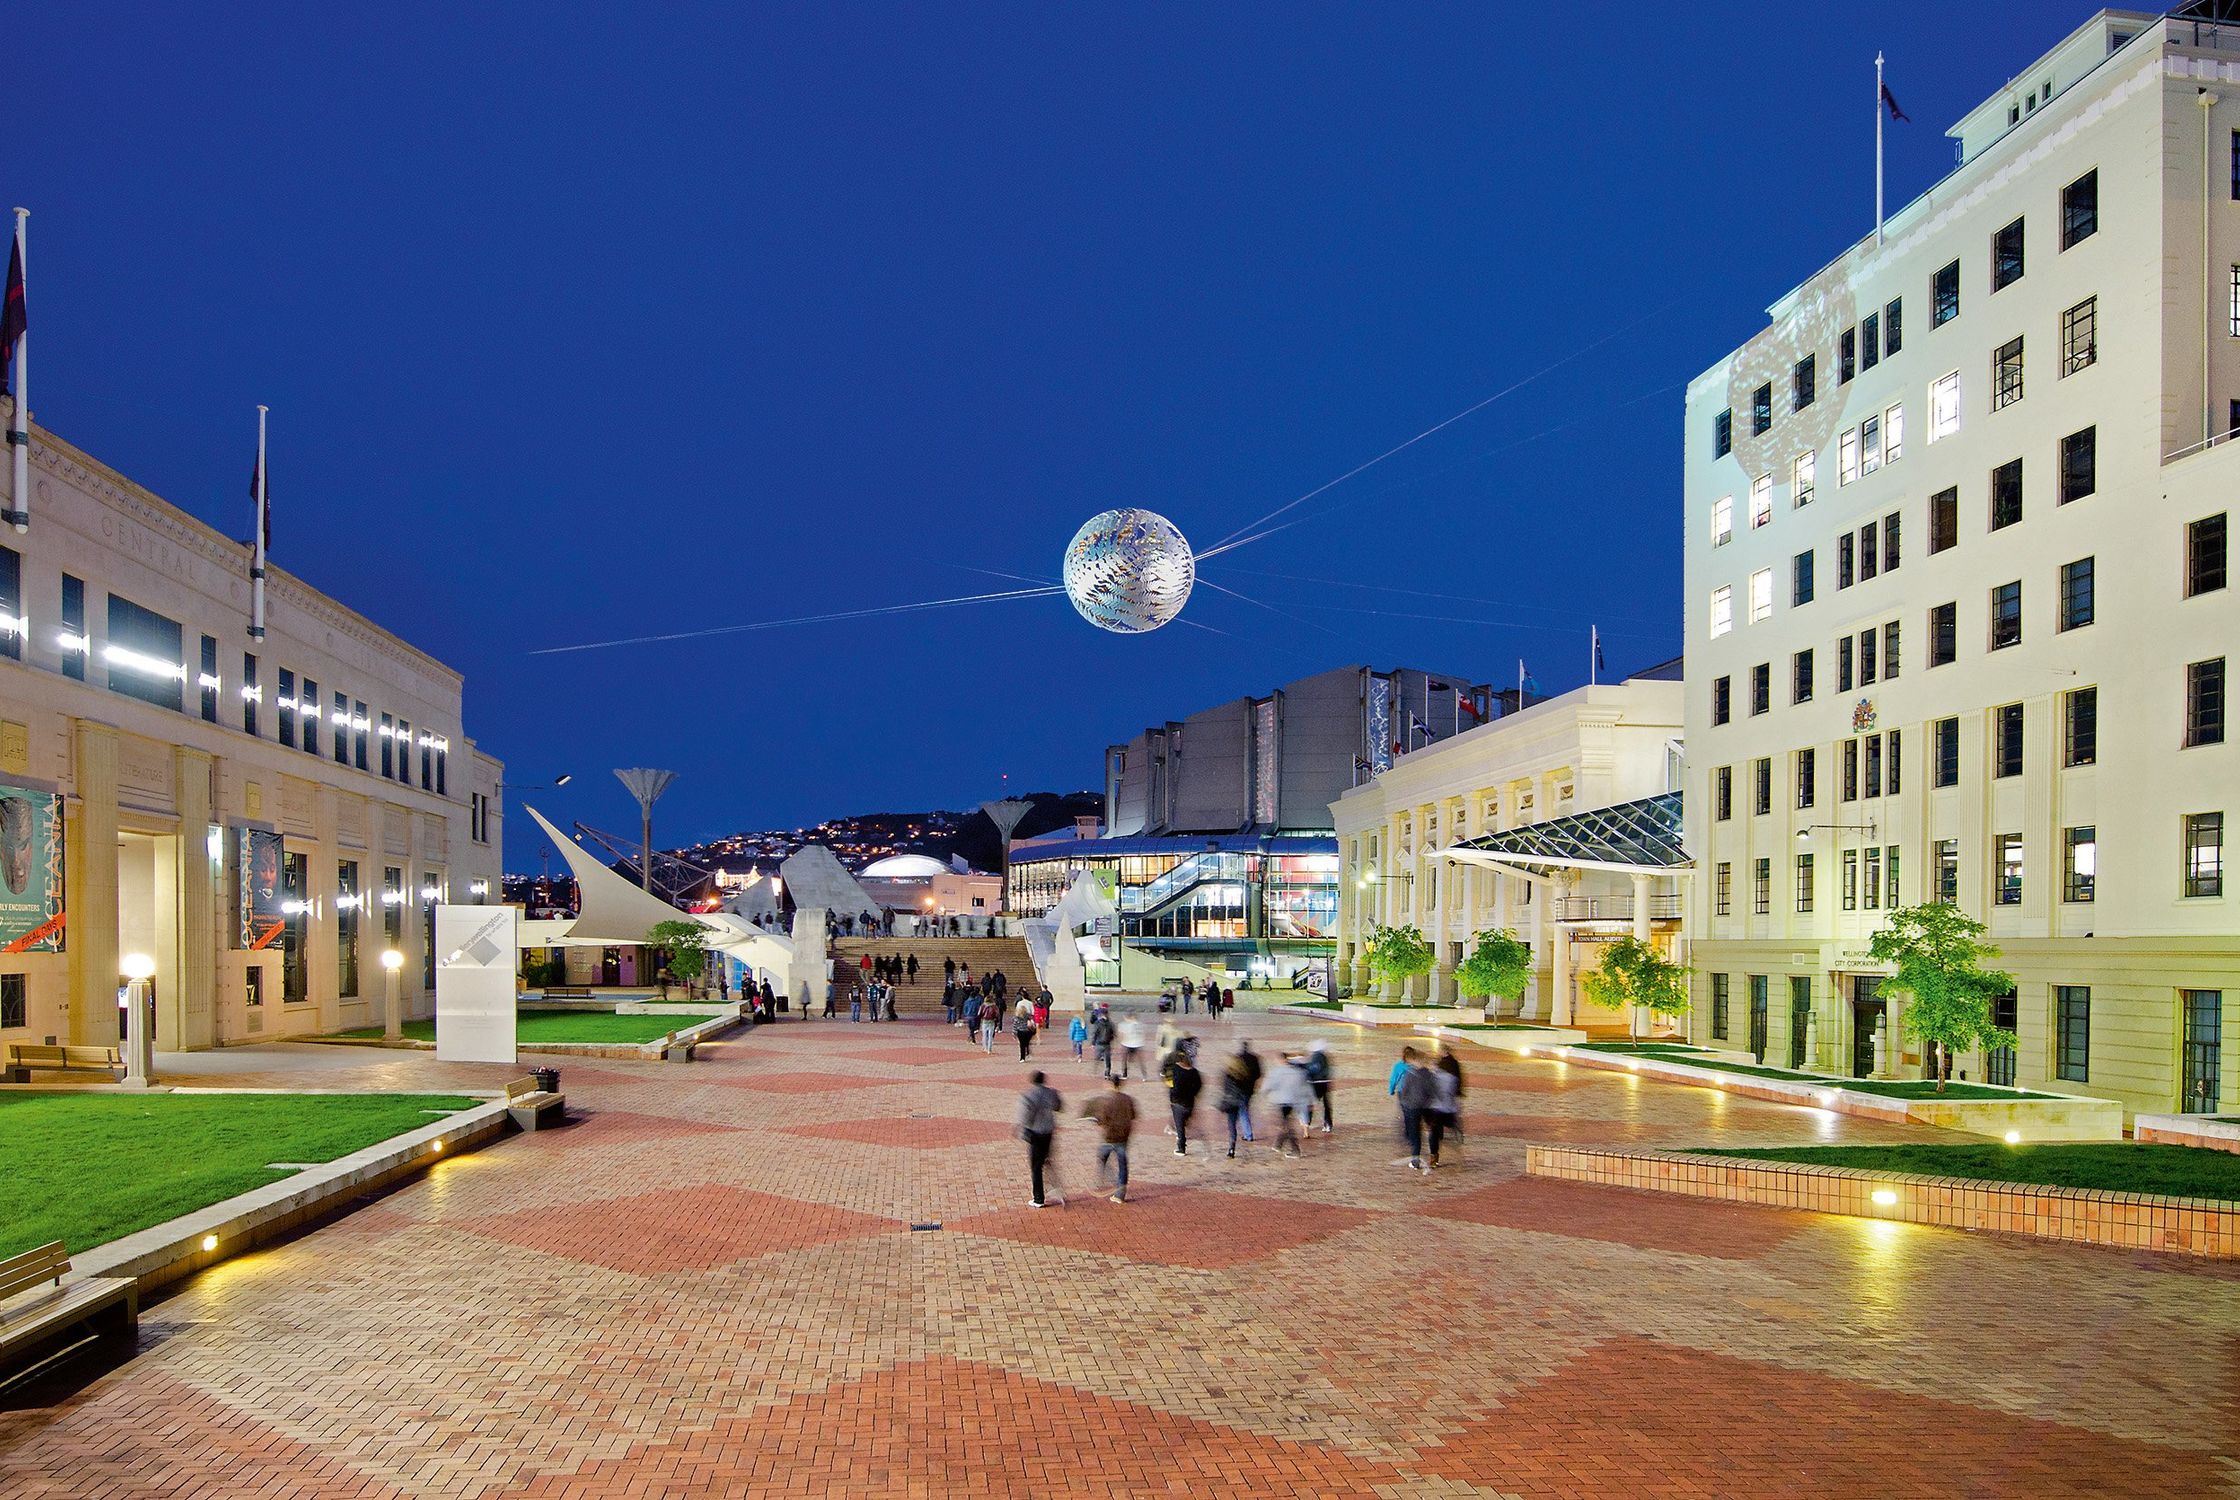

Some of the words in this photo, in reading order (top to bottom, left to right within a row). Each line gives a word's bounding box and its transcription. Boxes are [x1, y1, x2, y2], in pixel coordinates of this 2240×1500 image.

[101, 516, 198, 584] CENTRAL
[43, 800, 62, 947] OCEANIA
[10, 903, 40, 911] ENCOUNTERS
[22, 931, 41, 947] FINAL
